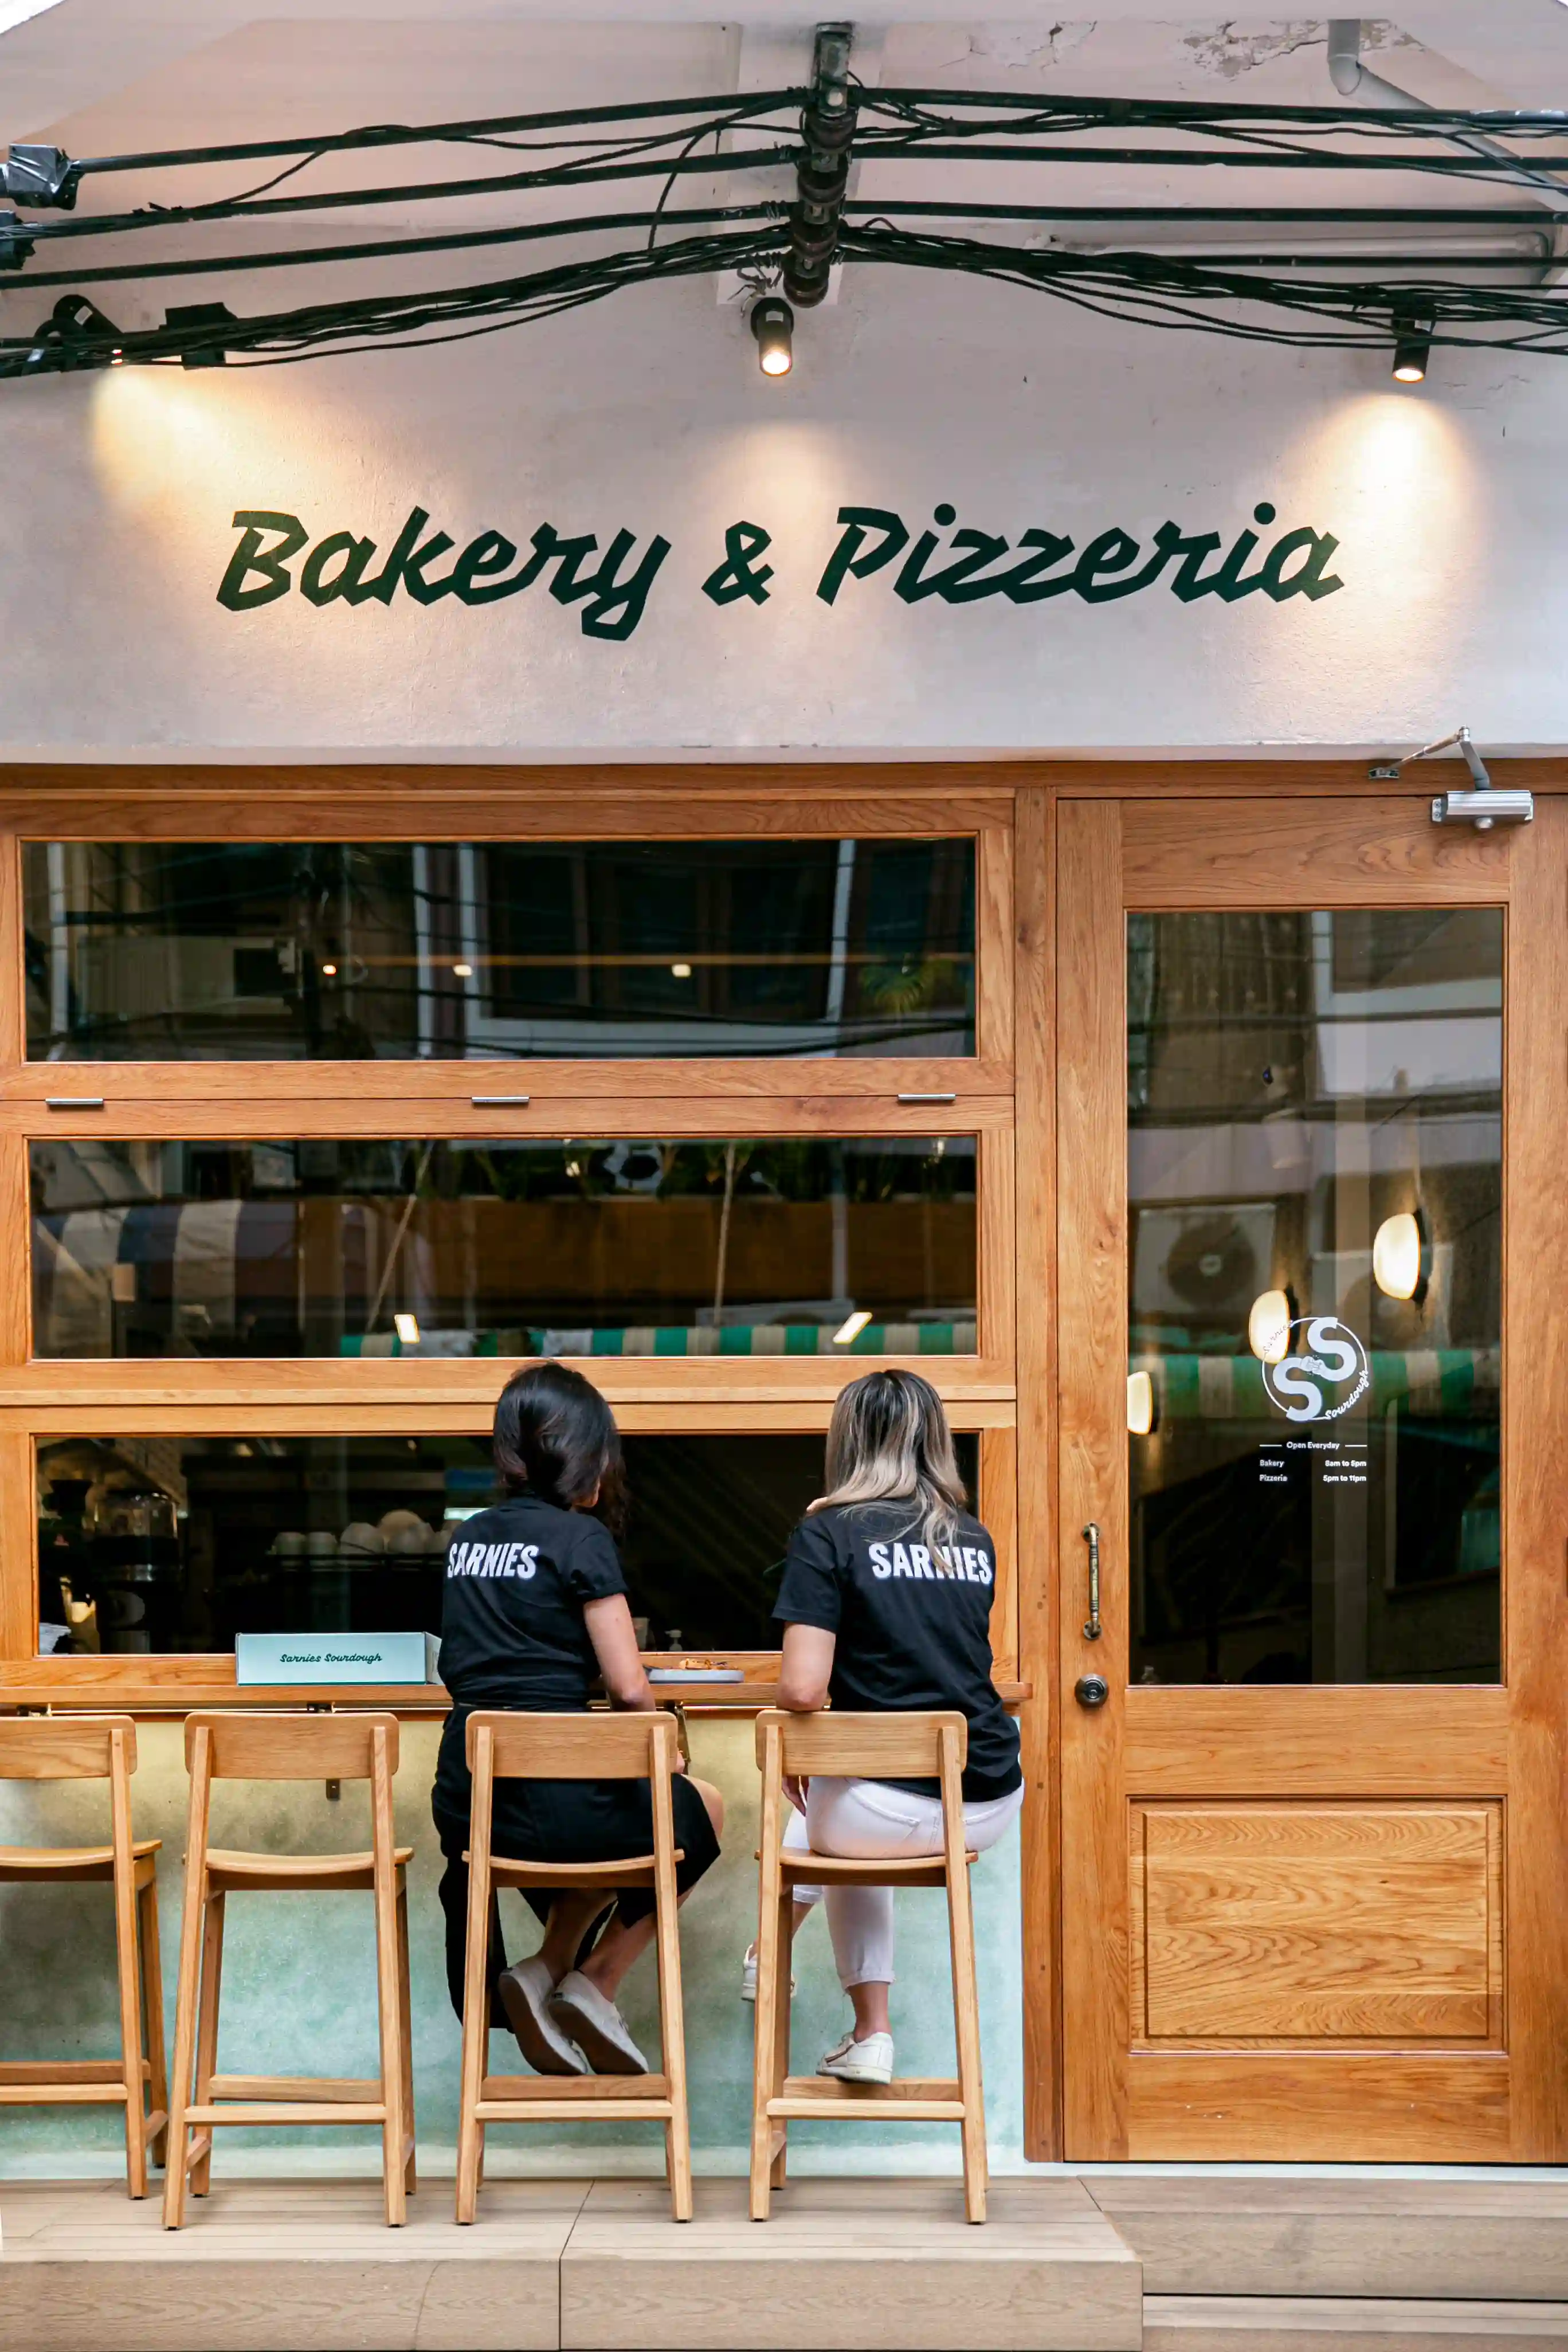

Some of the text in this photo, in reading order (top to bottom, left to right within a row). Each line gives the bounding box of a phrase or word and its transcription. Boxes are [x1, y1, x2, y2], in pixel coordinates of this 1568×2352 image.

[217, 503, 1345, 641] Bakery & Pizzeria
[1286, 1441, 1340, 1450] Open Everyday
[1259, 1459, 1285, 1468] Bakery
[1323, 1475, 1339, 1483] 5pm
[1349, 1475, 1367, 1483] 11pm
[446, 1542, 539, 1580] SARNIES
[280, 1653, 383, 1664] Sarnies Sourdough
